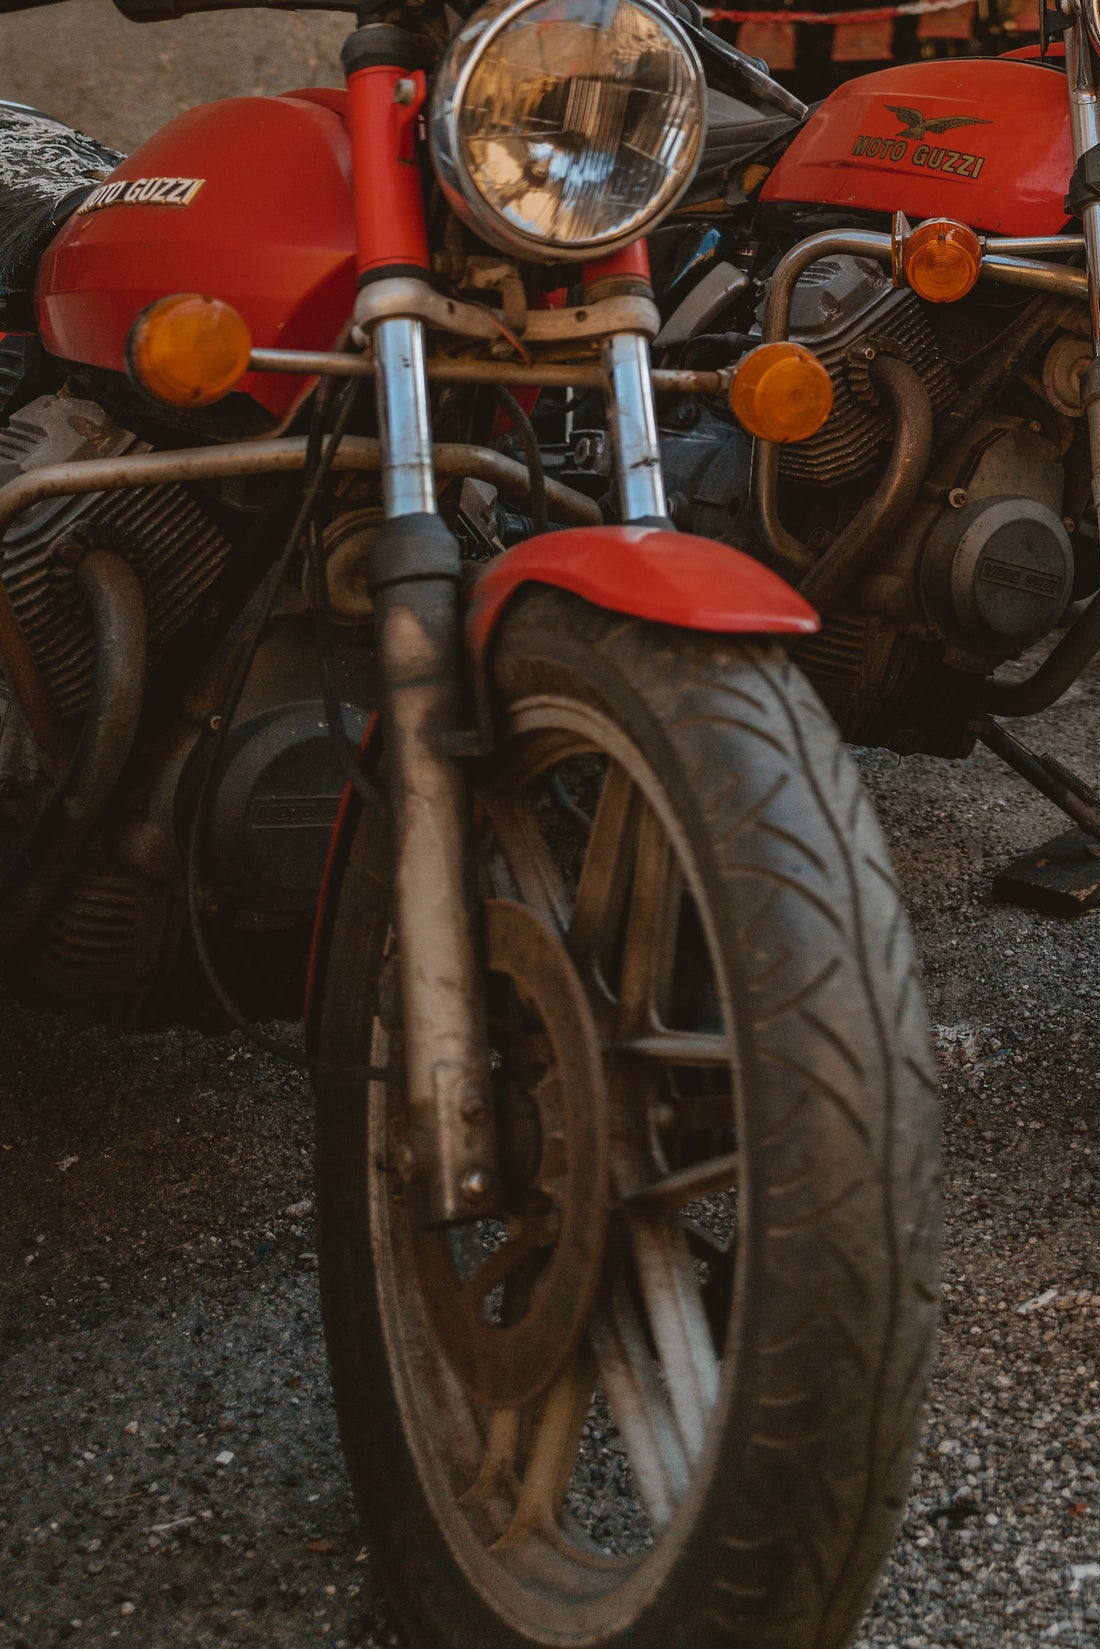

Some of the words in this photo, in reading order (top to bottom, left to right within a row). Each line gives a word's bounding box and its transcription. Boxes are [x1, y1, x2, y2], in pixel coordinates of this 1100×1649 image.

[851, 135, 908, 162] MOTO
[912, 144, 985, 180] GUZZI
[124, 177, 205, 205] GUZZI
